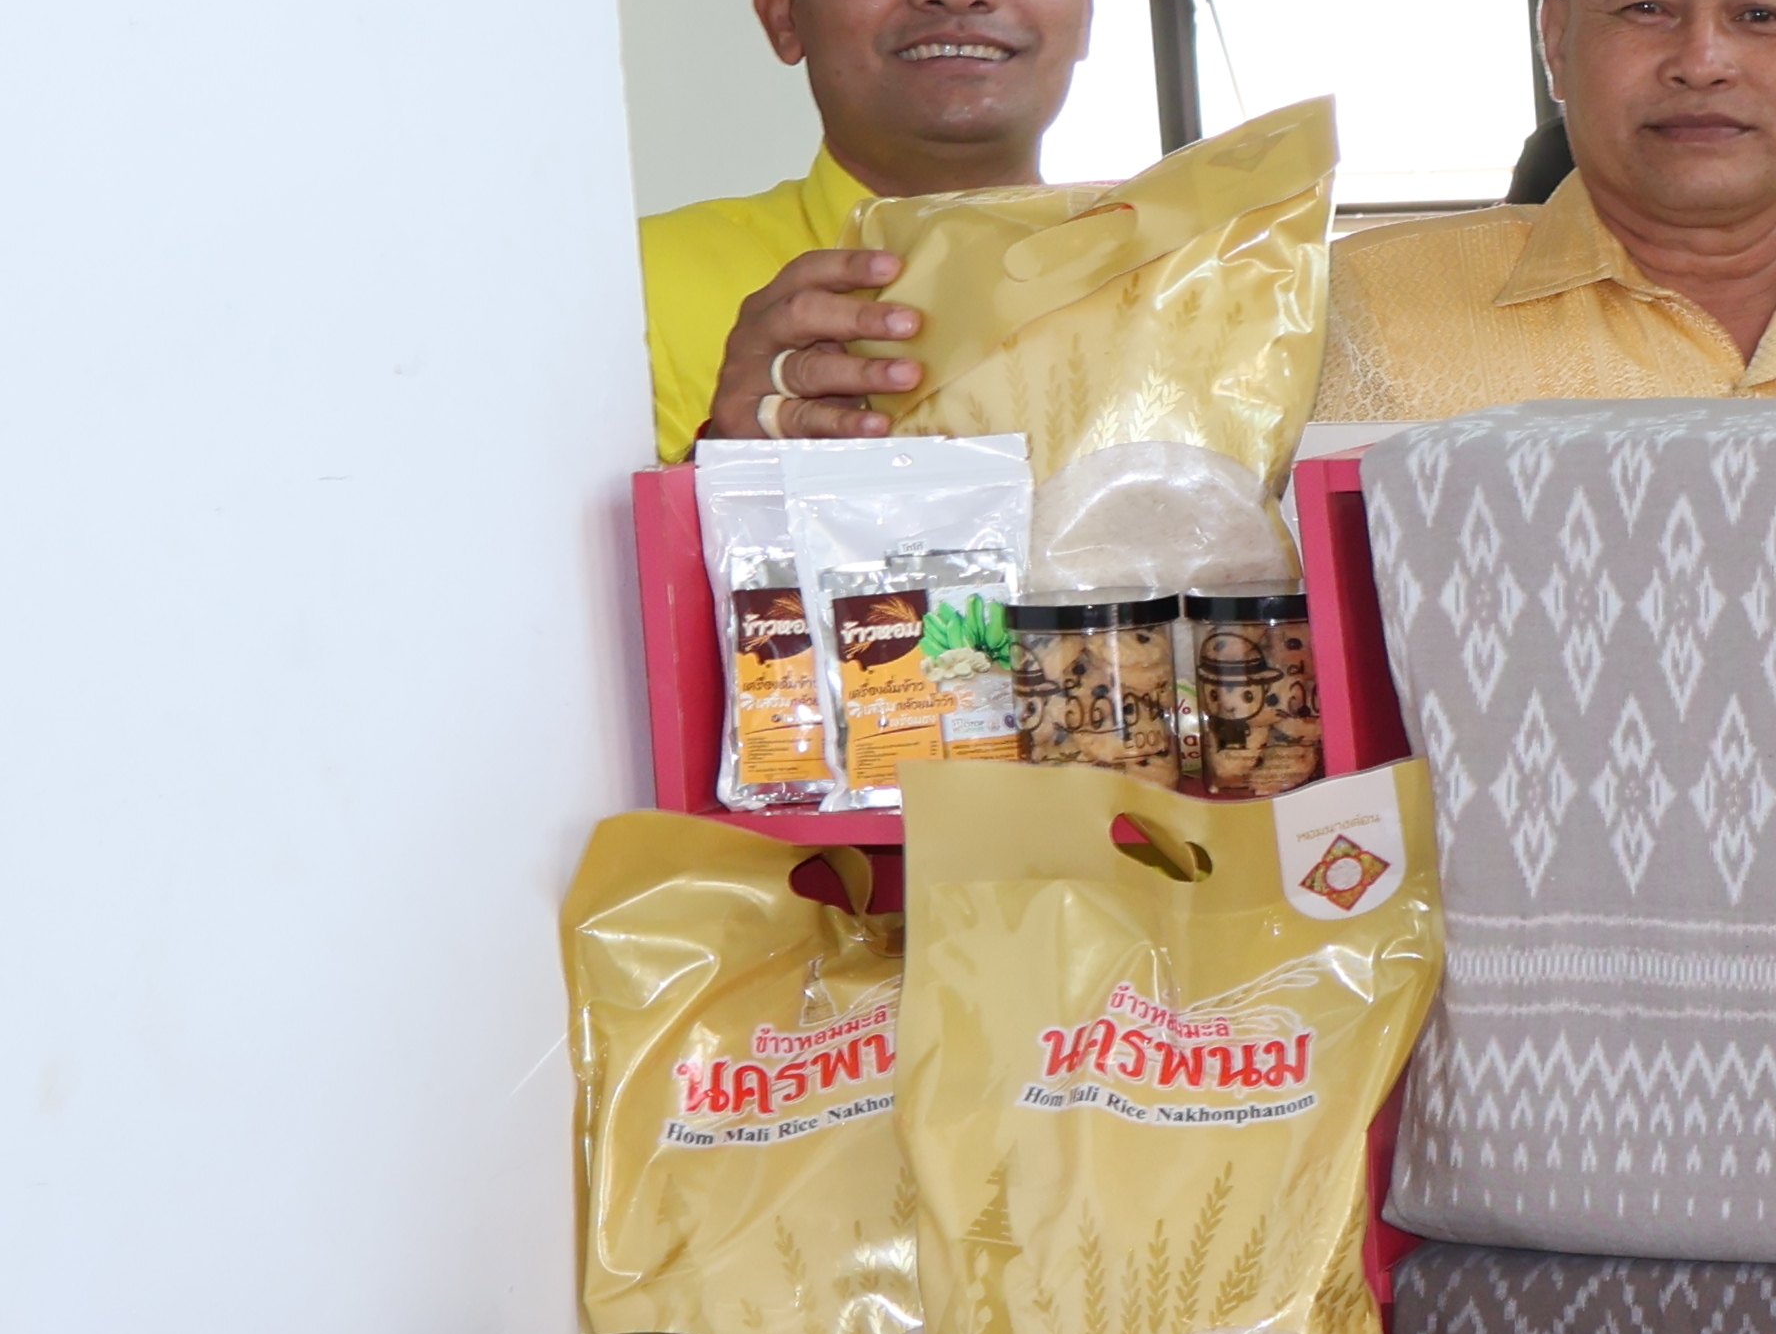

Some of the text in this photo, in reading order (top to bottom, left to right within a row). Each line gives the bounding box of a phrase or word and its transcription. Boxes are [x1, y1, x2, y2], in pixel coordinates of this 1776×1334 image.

[1023, 1085, 1065, 1107] Hom
[1106, 1093, 1148, 1121] Rice
[1155, 1093, 1316, 1124] Nakhonphanom
[666, 1122, 715, 1146] Hom
[722, 1123, 770, 1143] Mali
[777, 1117, 819, 1140] Rice
